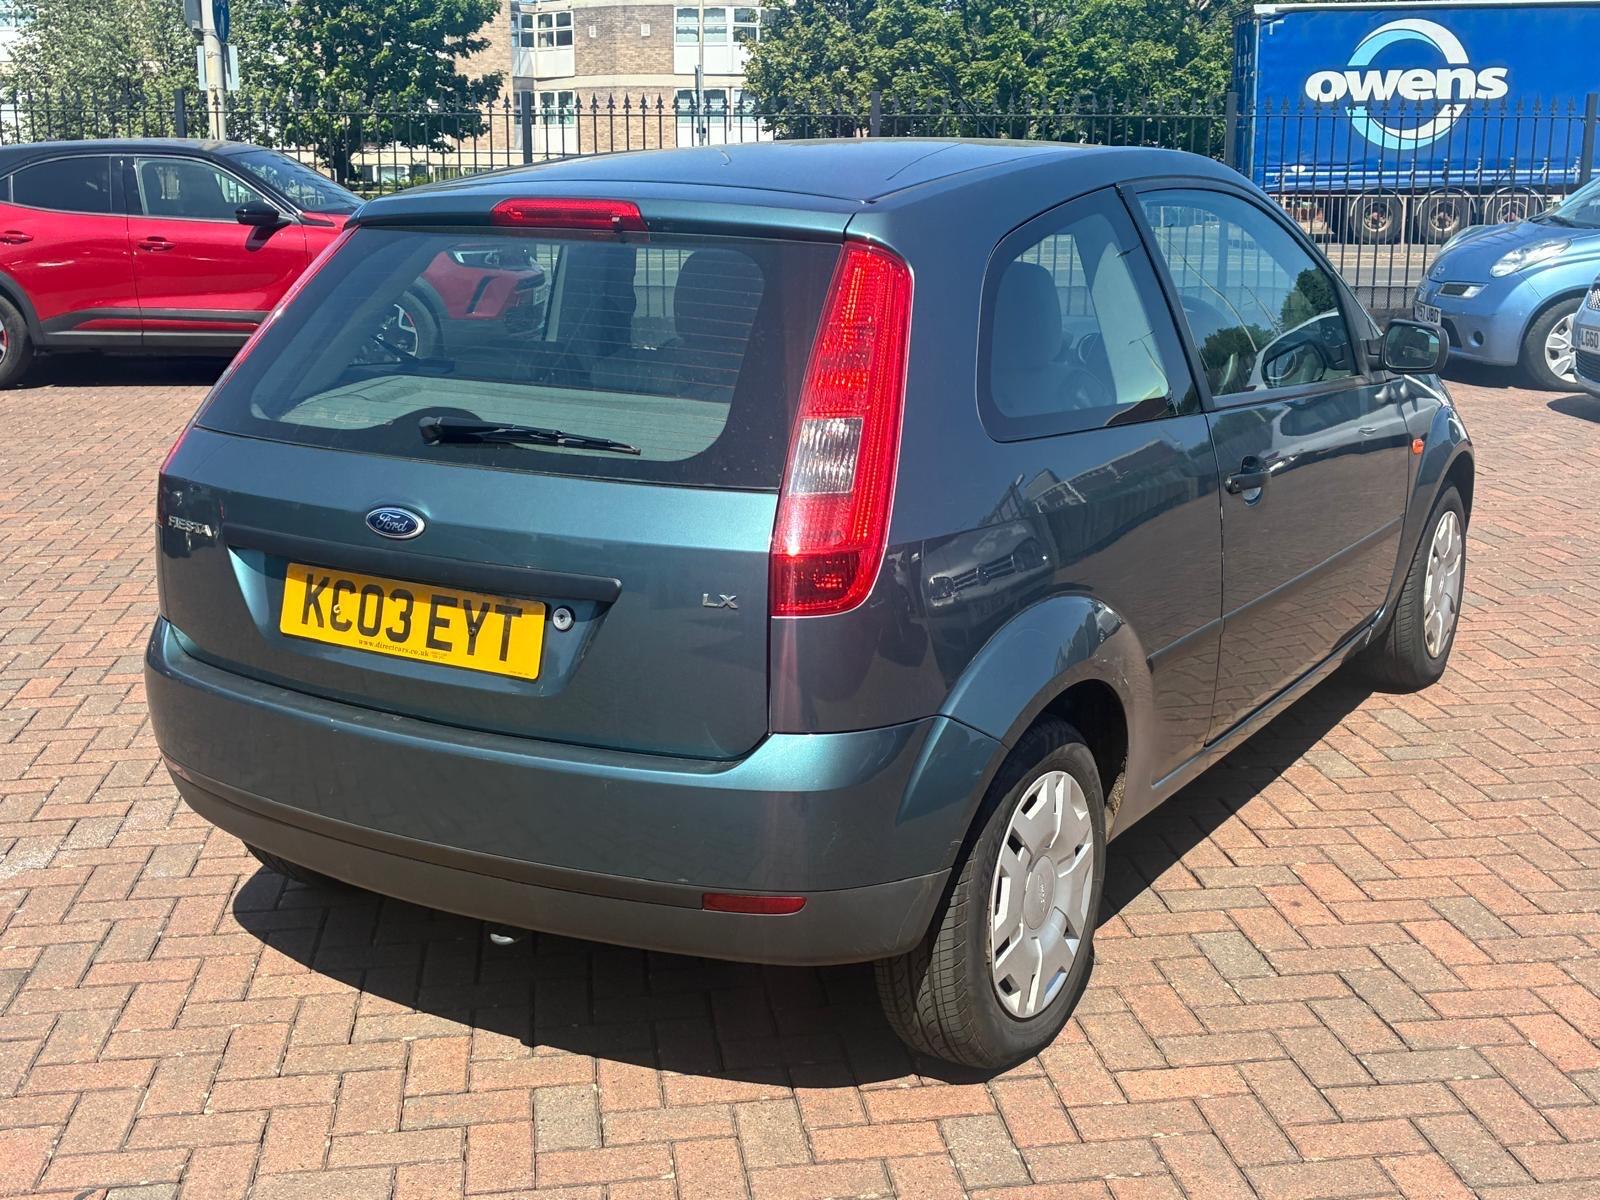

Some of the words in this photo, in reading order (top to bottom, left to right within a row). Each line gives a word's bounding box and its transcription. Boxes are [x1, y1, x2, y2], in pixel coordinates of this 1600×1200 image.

[1305, 67, 1509, 103] owens
[168, 514, 213, 537] FIESTA
[376, 512, 408, 532] Ford
[702, 593, 738, 609] LX
[301, 573, 414, 643] KC03
[425, 594, 523, 662] EYT
[358, 639, 429, 657] www.directcars.co.uk
